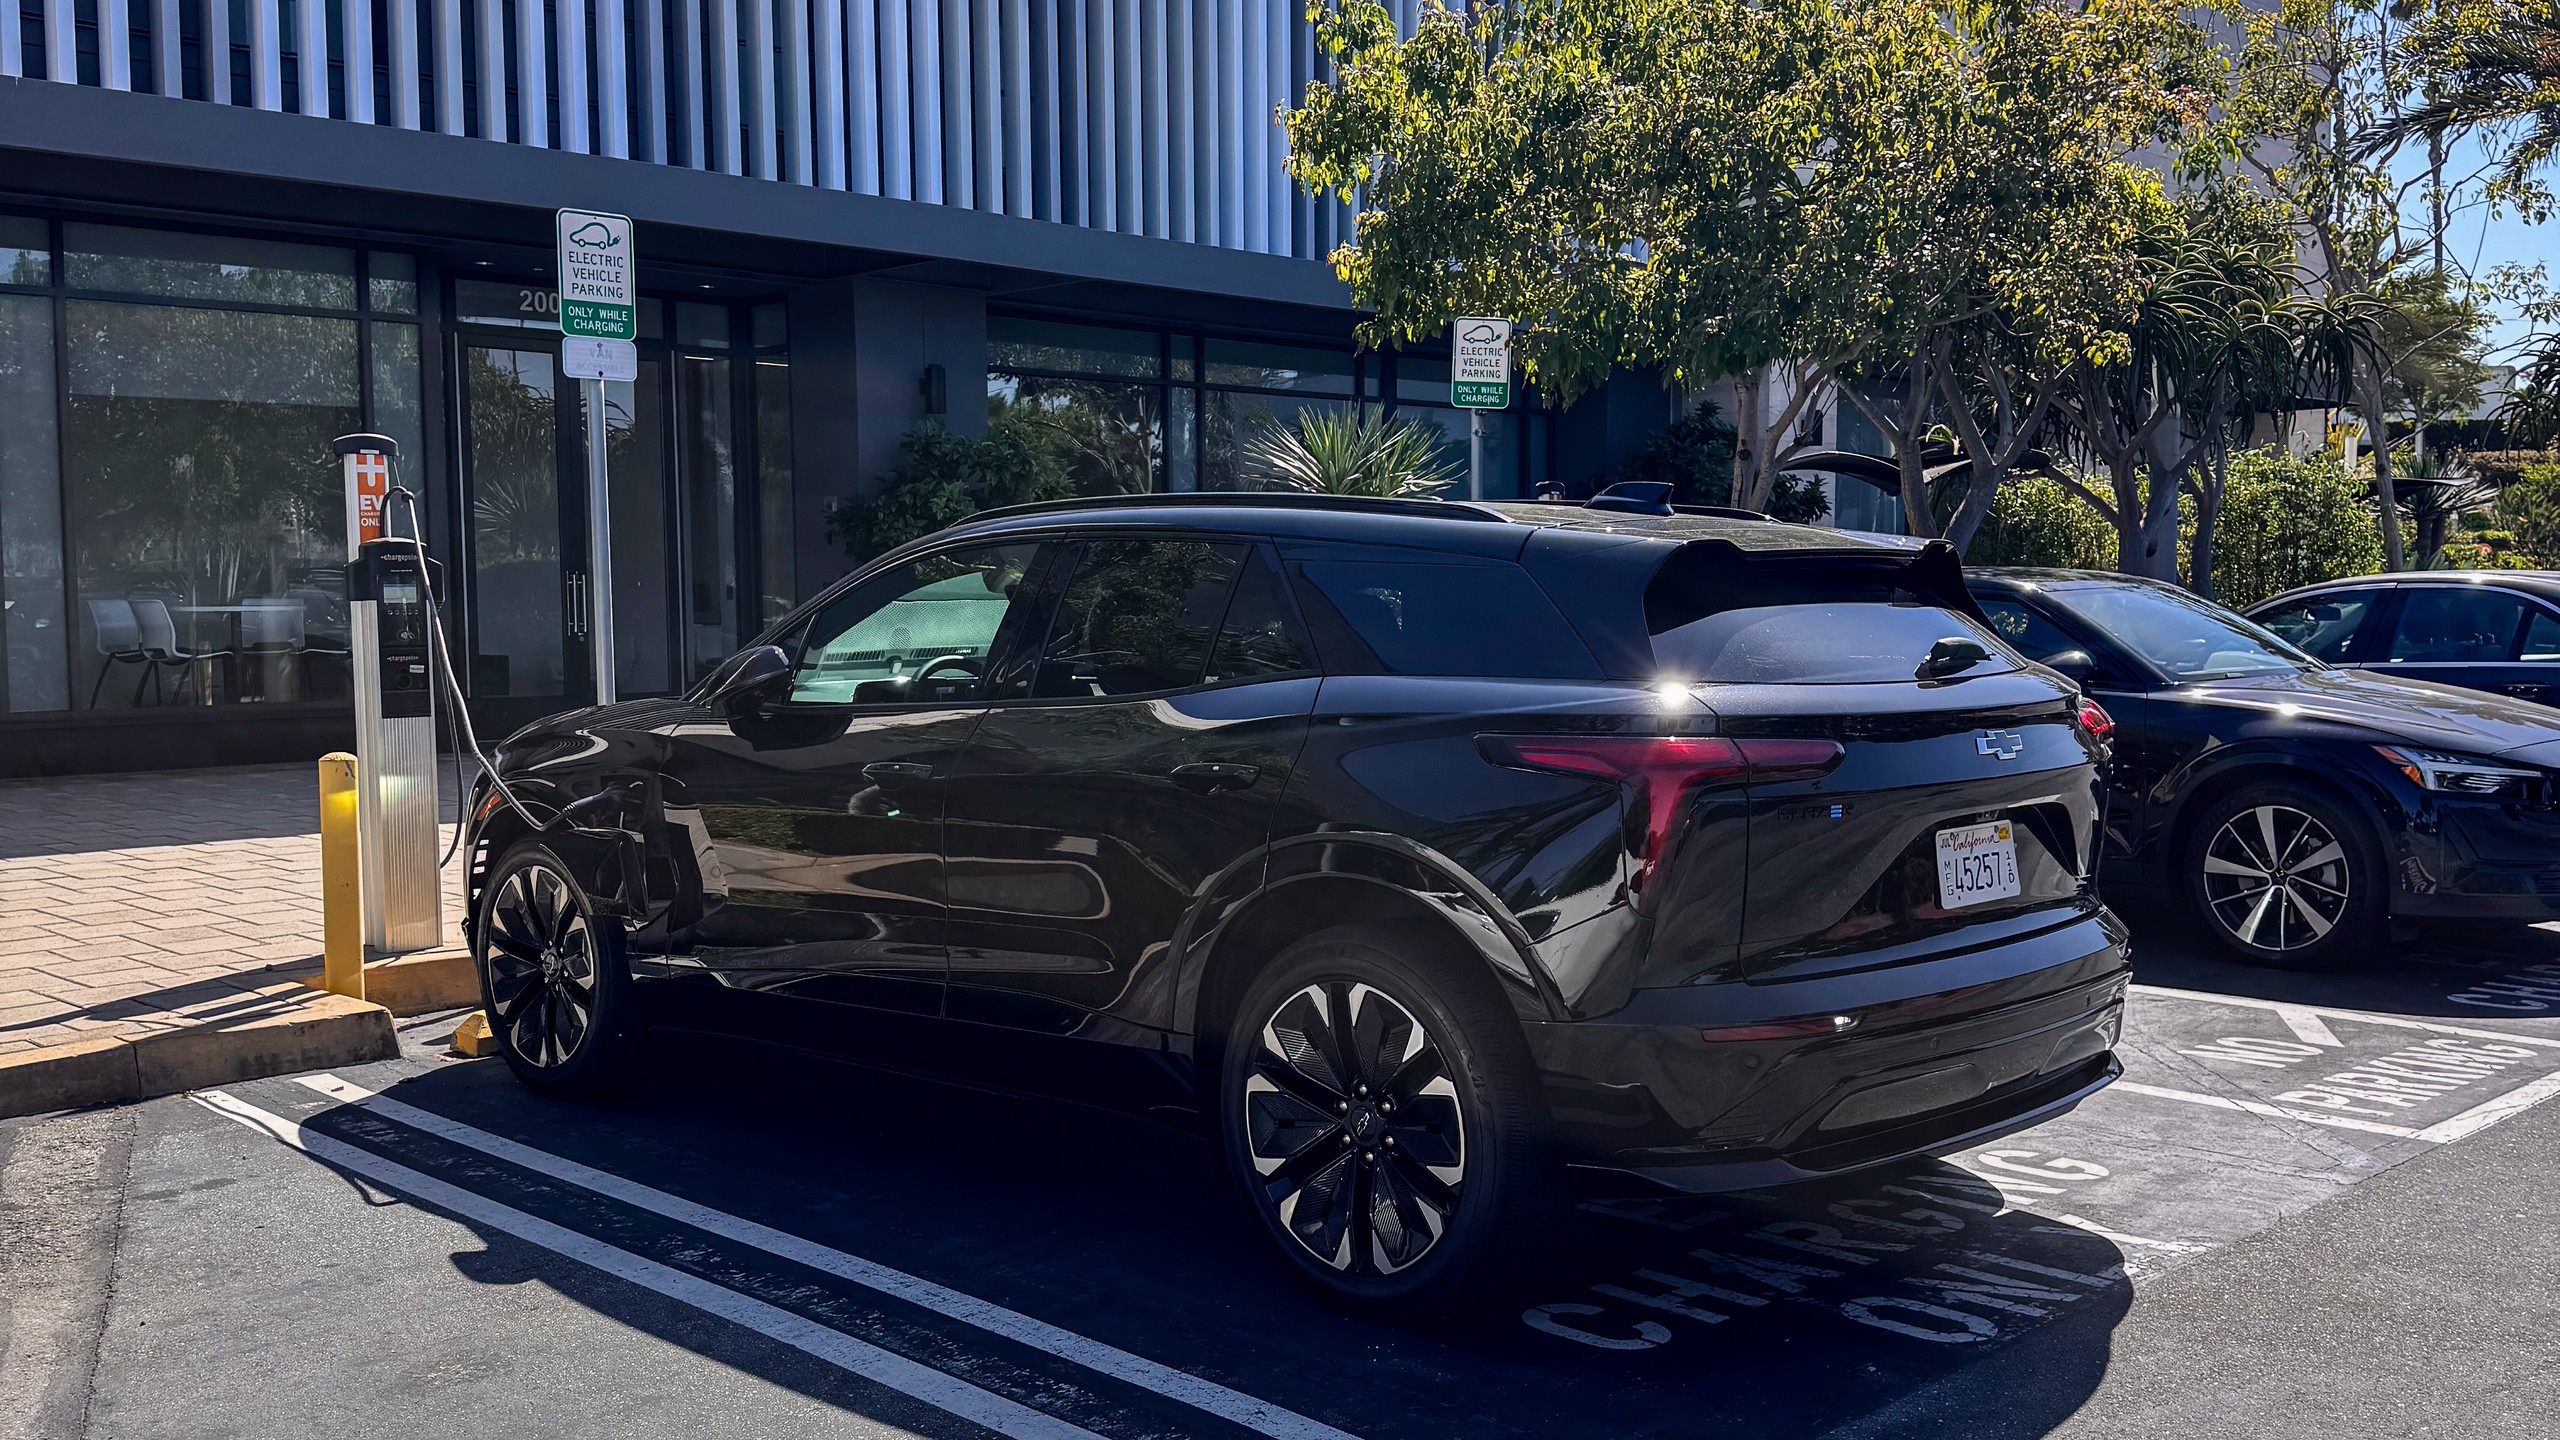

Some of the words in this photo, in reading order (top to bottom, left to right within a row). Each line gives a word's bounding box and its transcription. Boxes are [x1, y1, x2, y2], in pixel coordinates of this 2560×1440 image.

[568, 251, 624, 268] ELECTRIC
[572, 268, 622, 283] VEHICLE
[571, 283, 623, 299] PARKING
[568, 305, 594, 318] ONLY
[599, 308, 628, 321] WHILE
[573, 319, 624, 333] CHARGING
[1460, 346, 1503, 357] ELECTRIC
[1463, 358, 1500, 367] VEHICLE
[1461, 369, 1501, 379] PARKING
[1457, 385, 1477, 393] ONLY
[1481, 386, 1503, 395] WHILE
[1461, 394, 1500, 403] CHARGING
[360, 494, 384, 511] EV
[360, 518, 380, 527] ONL
[1950, 831, 2000, 854] California
[1955, 851, 2001, 893] 45257
[2177, 1037, 2324, 1069] NO
[2271, 1038, 2538, 1117] PARKING
[1522, 1149, 2110, 1350] CHARGING
